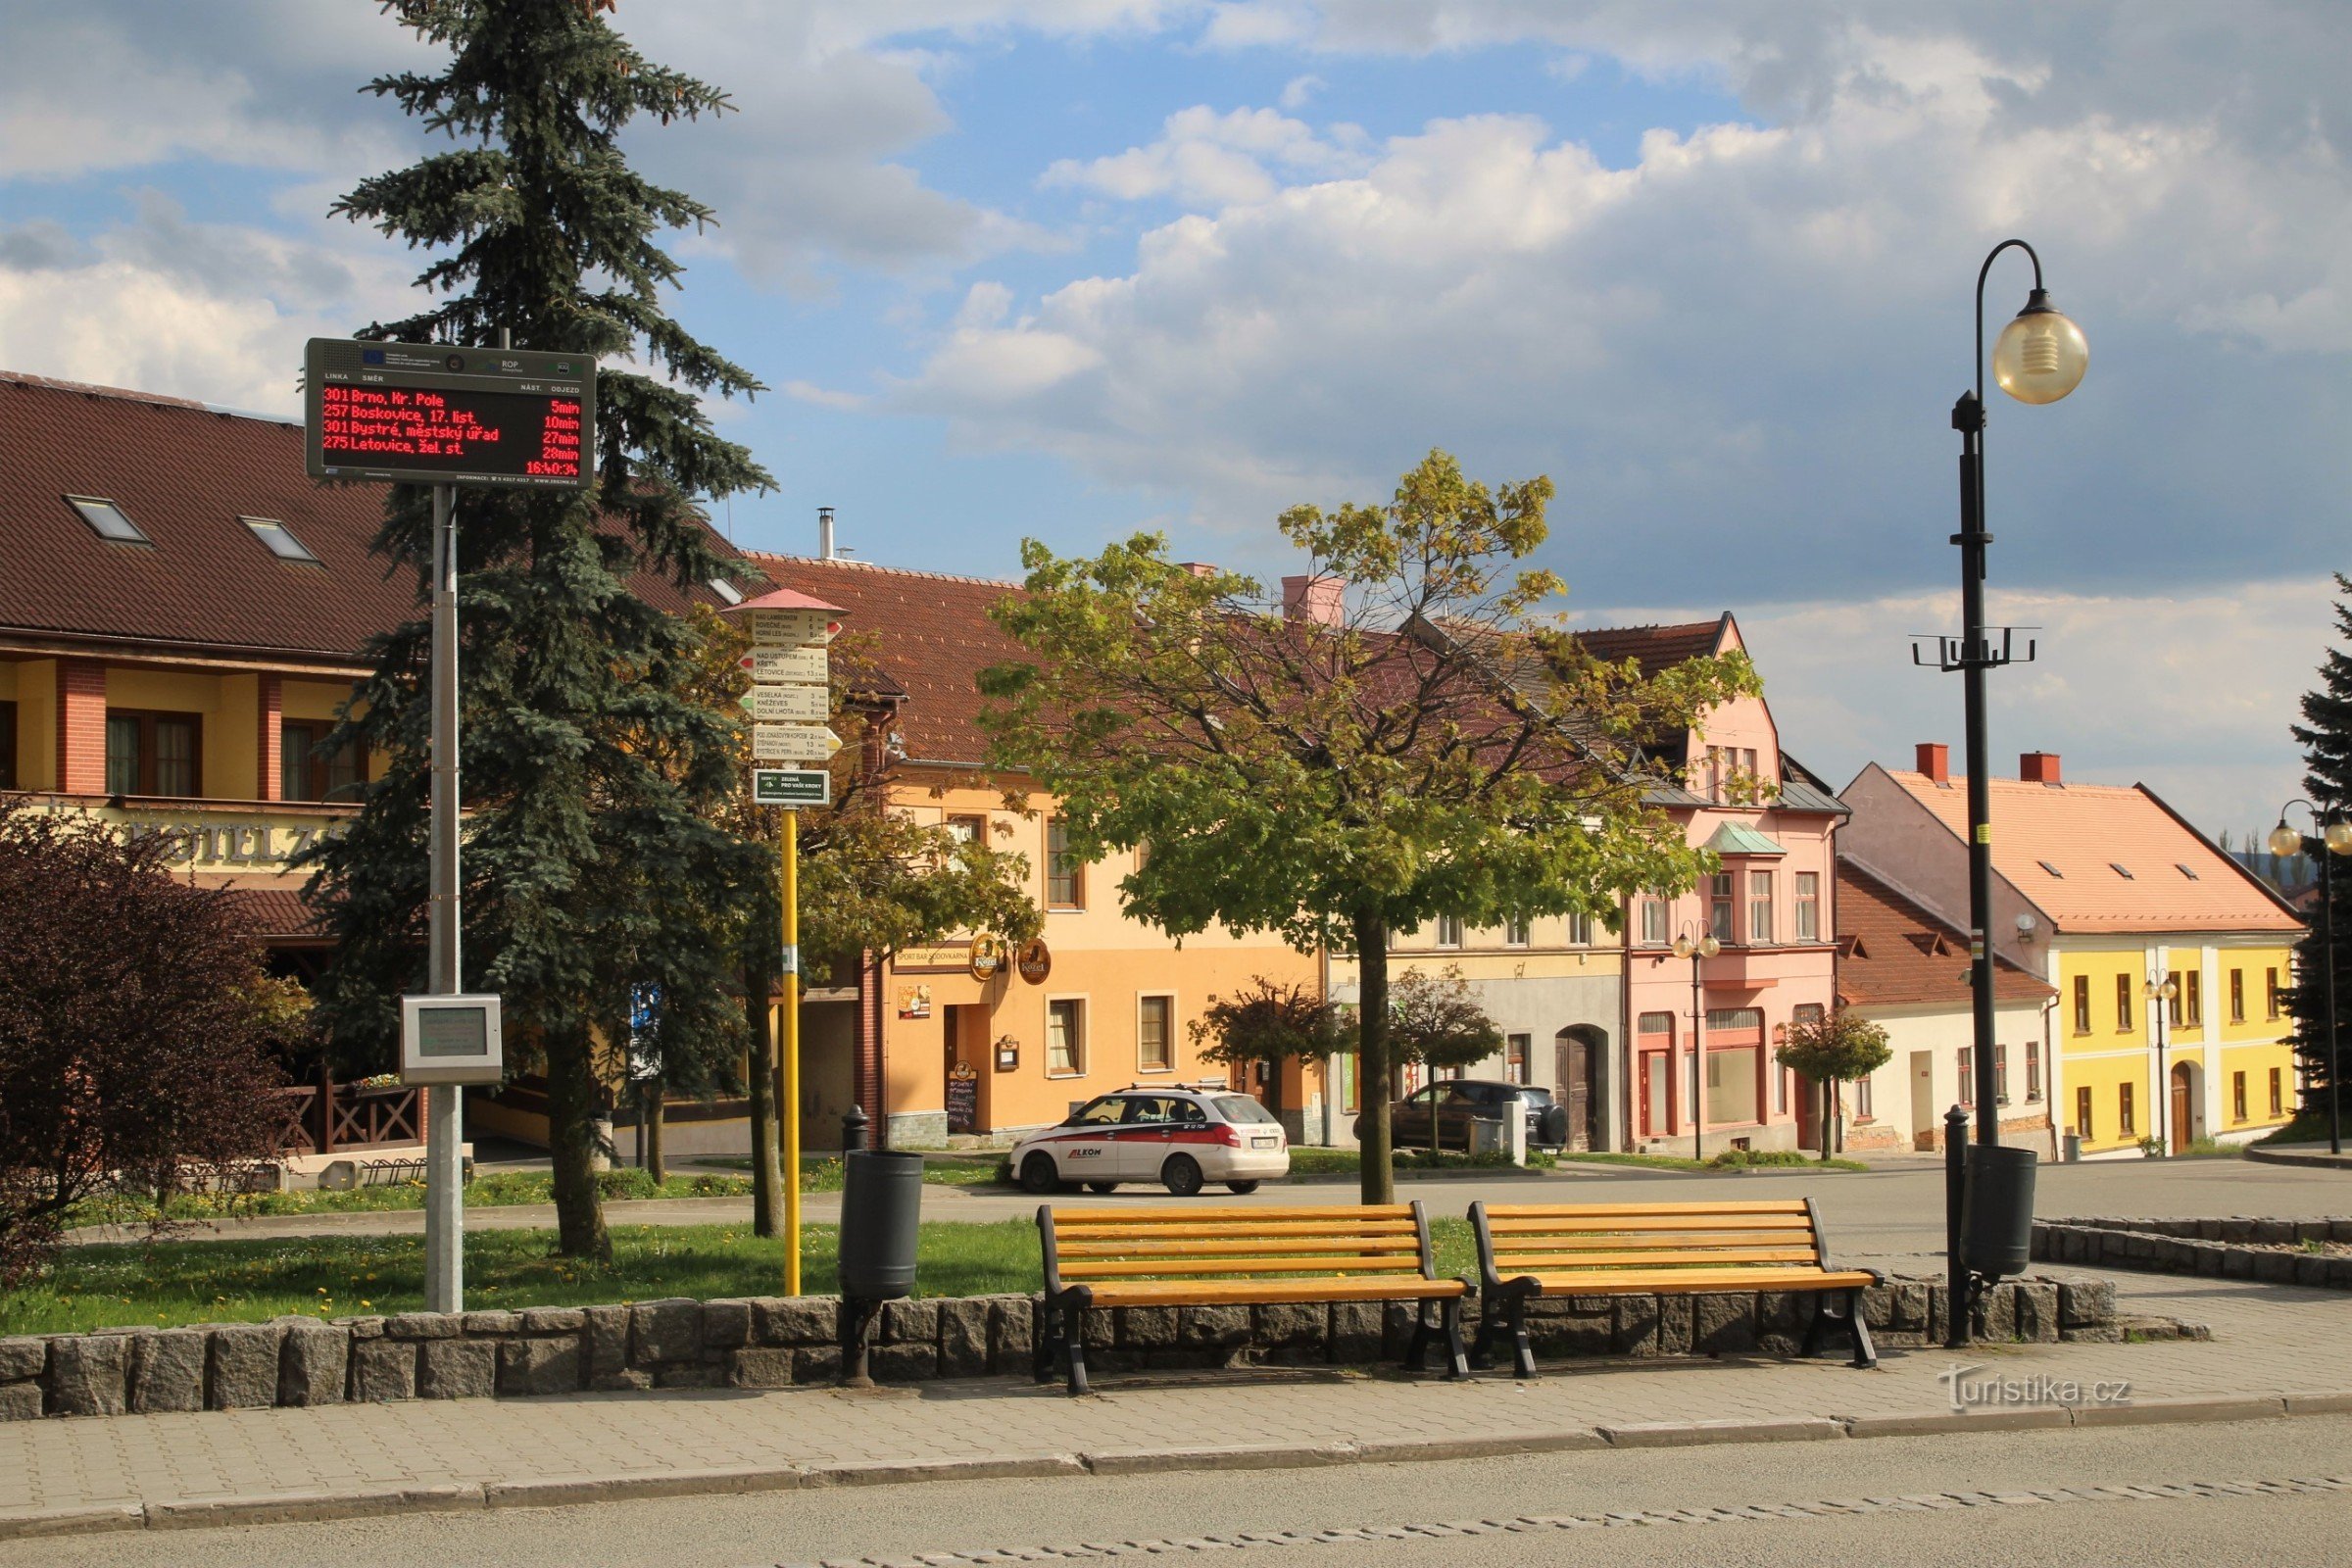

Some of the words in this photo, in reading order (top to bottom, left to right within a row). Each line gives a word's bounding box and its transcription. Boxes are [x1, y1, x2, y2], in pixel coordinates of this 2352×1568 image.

[520, 383, 542, 392] NÁST.
[324, 388, 349, 403] 301
[352, 389, 388, 406] Brno,
[416, 393, 444, 407] Pole
[551, 400, 579, 415] 5min
[323, 405, 348, 417] 257
[352, 405, 424, 422] Boskovice,
[430, 410, 449, 422] 17.
[453, 410, 476, 424] list.
[545, 416, 579, 429] 10min
[323, 419, 348, 433] 301
[352, 420, 402, 438] Bystré,
[406, 422, 463, 441] městský
[467, 425, 499, 441] úřad
[543, 431, 578, 445] 27min
[323, 435, 348, 449] 275
[351, 437, 415, 454] Letovice,
[419, 438, 441, 454] žel.
[446, 442, 464, 455] st.
[543, 447, 578, 461] 28min
[526, 461, 578, 475] 16:40:34
[975, 956, 998, 967] Kozel
[1021, 962, 1046, 973] Kozel
[1068, 1149, 1102, 1158] ALKOM
